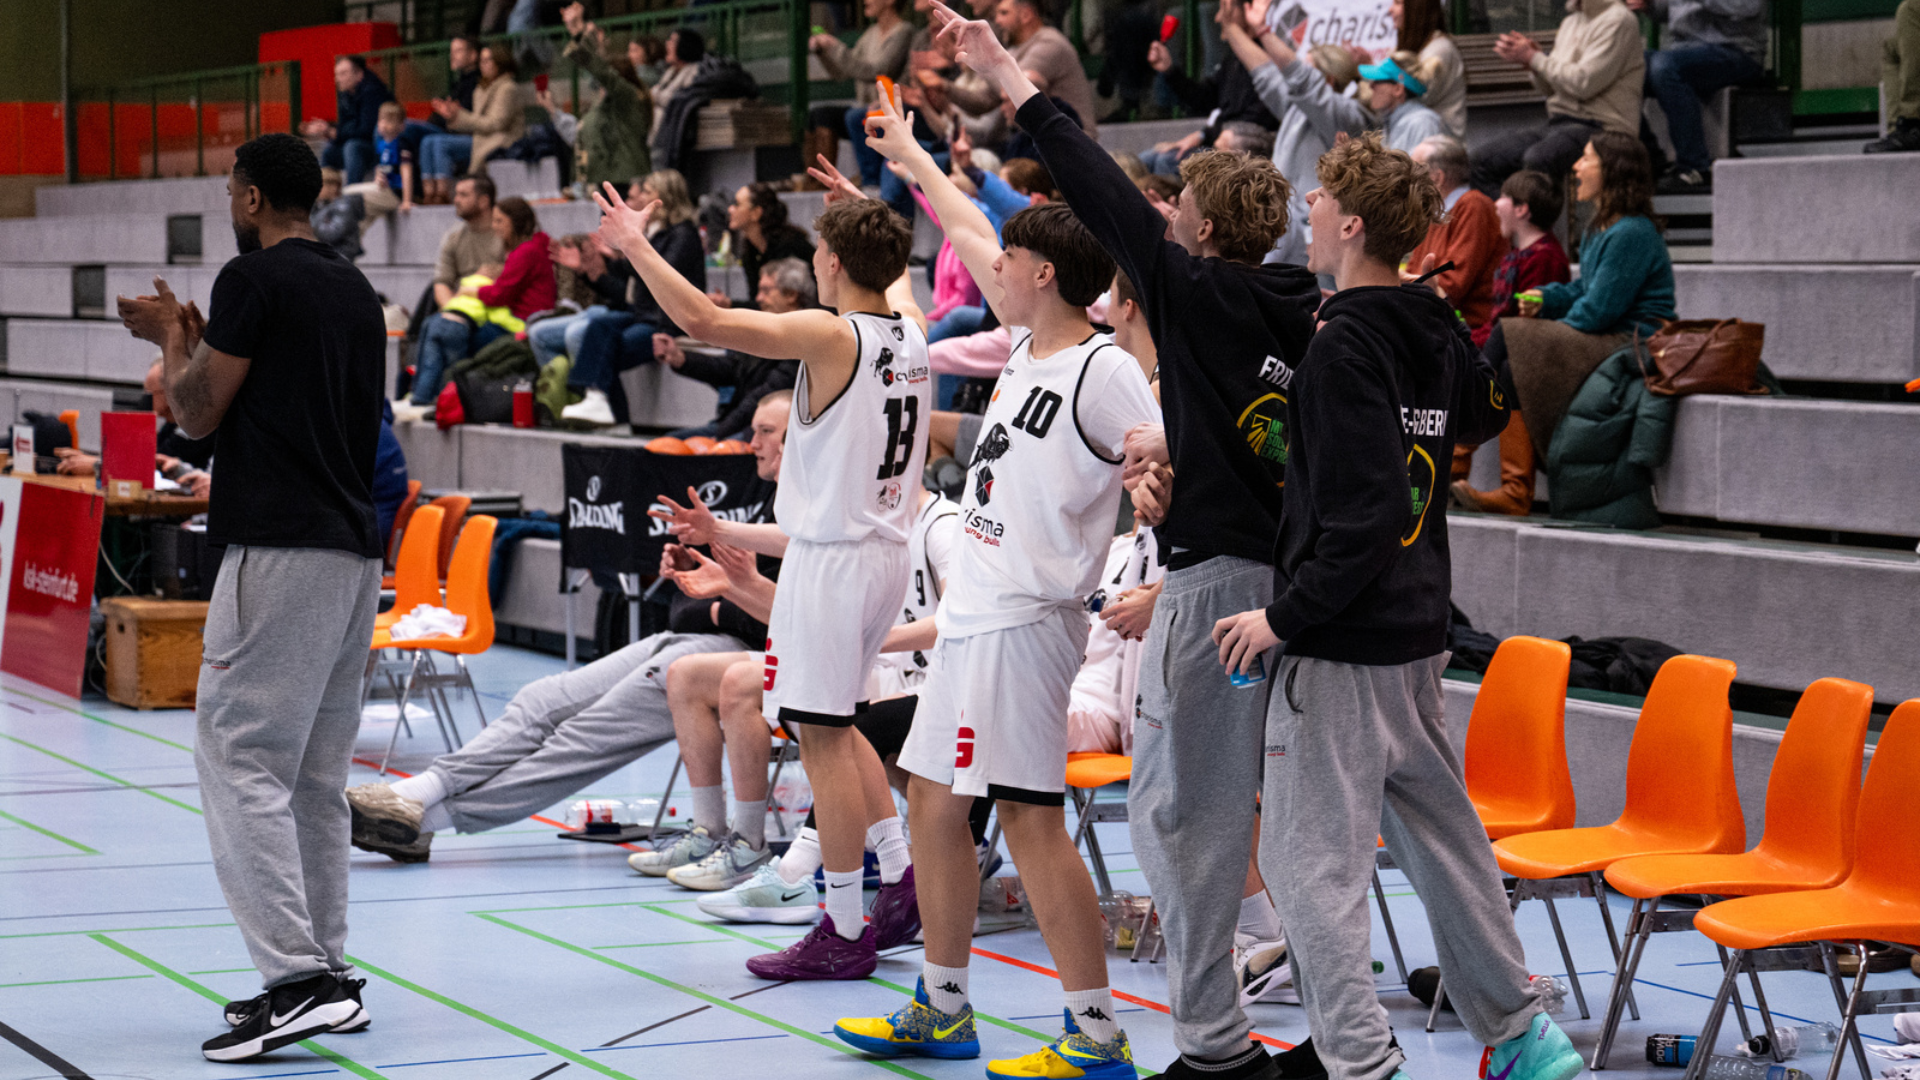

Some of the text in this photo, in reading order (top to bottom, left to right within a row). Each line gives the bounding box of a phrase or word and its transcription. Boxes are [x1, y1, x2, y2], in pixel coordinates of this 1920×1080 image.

[1309, 6, 1395, 46] charis
[1011, 385, 1063, 439] 10
[876, 395, 918, 480] 13
[1266, 432, 1287, 451] SOL
[915, 569, 926, 607] 9
